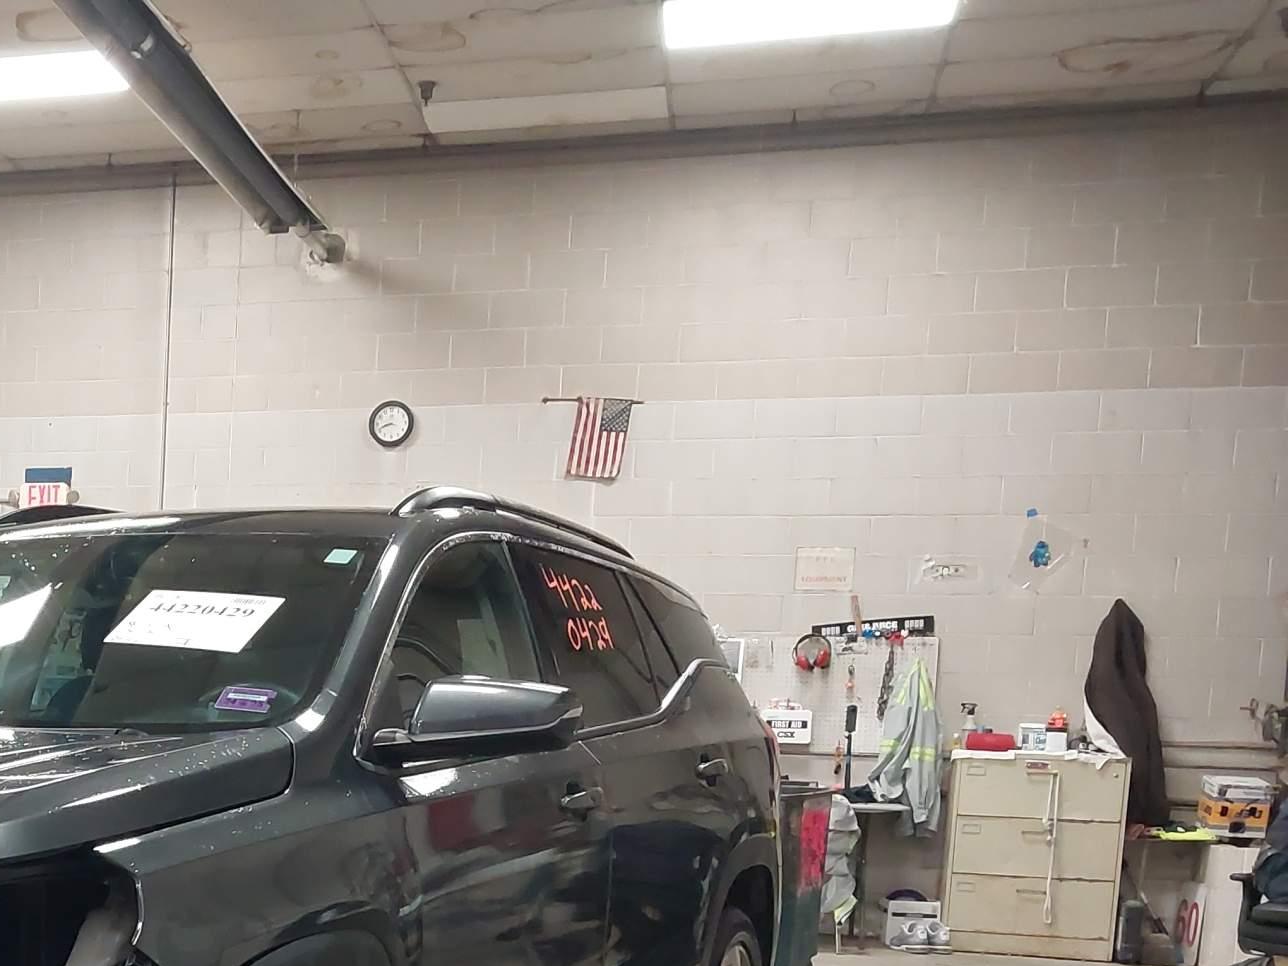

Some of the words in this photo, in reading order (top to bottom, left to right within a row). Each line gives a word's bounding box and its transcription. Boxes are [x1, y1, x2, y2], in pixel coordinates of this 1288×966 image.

[28, 485, 60, 505] EXIT
[539, 563, 603, 611] 4422
[149, 603, 256, 618] 44220429
[568, 617, 614, 650] 0429
[772, 720, 789, 728] FIRST
[791, 720, 803, 728] AID
